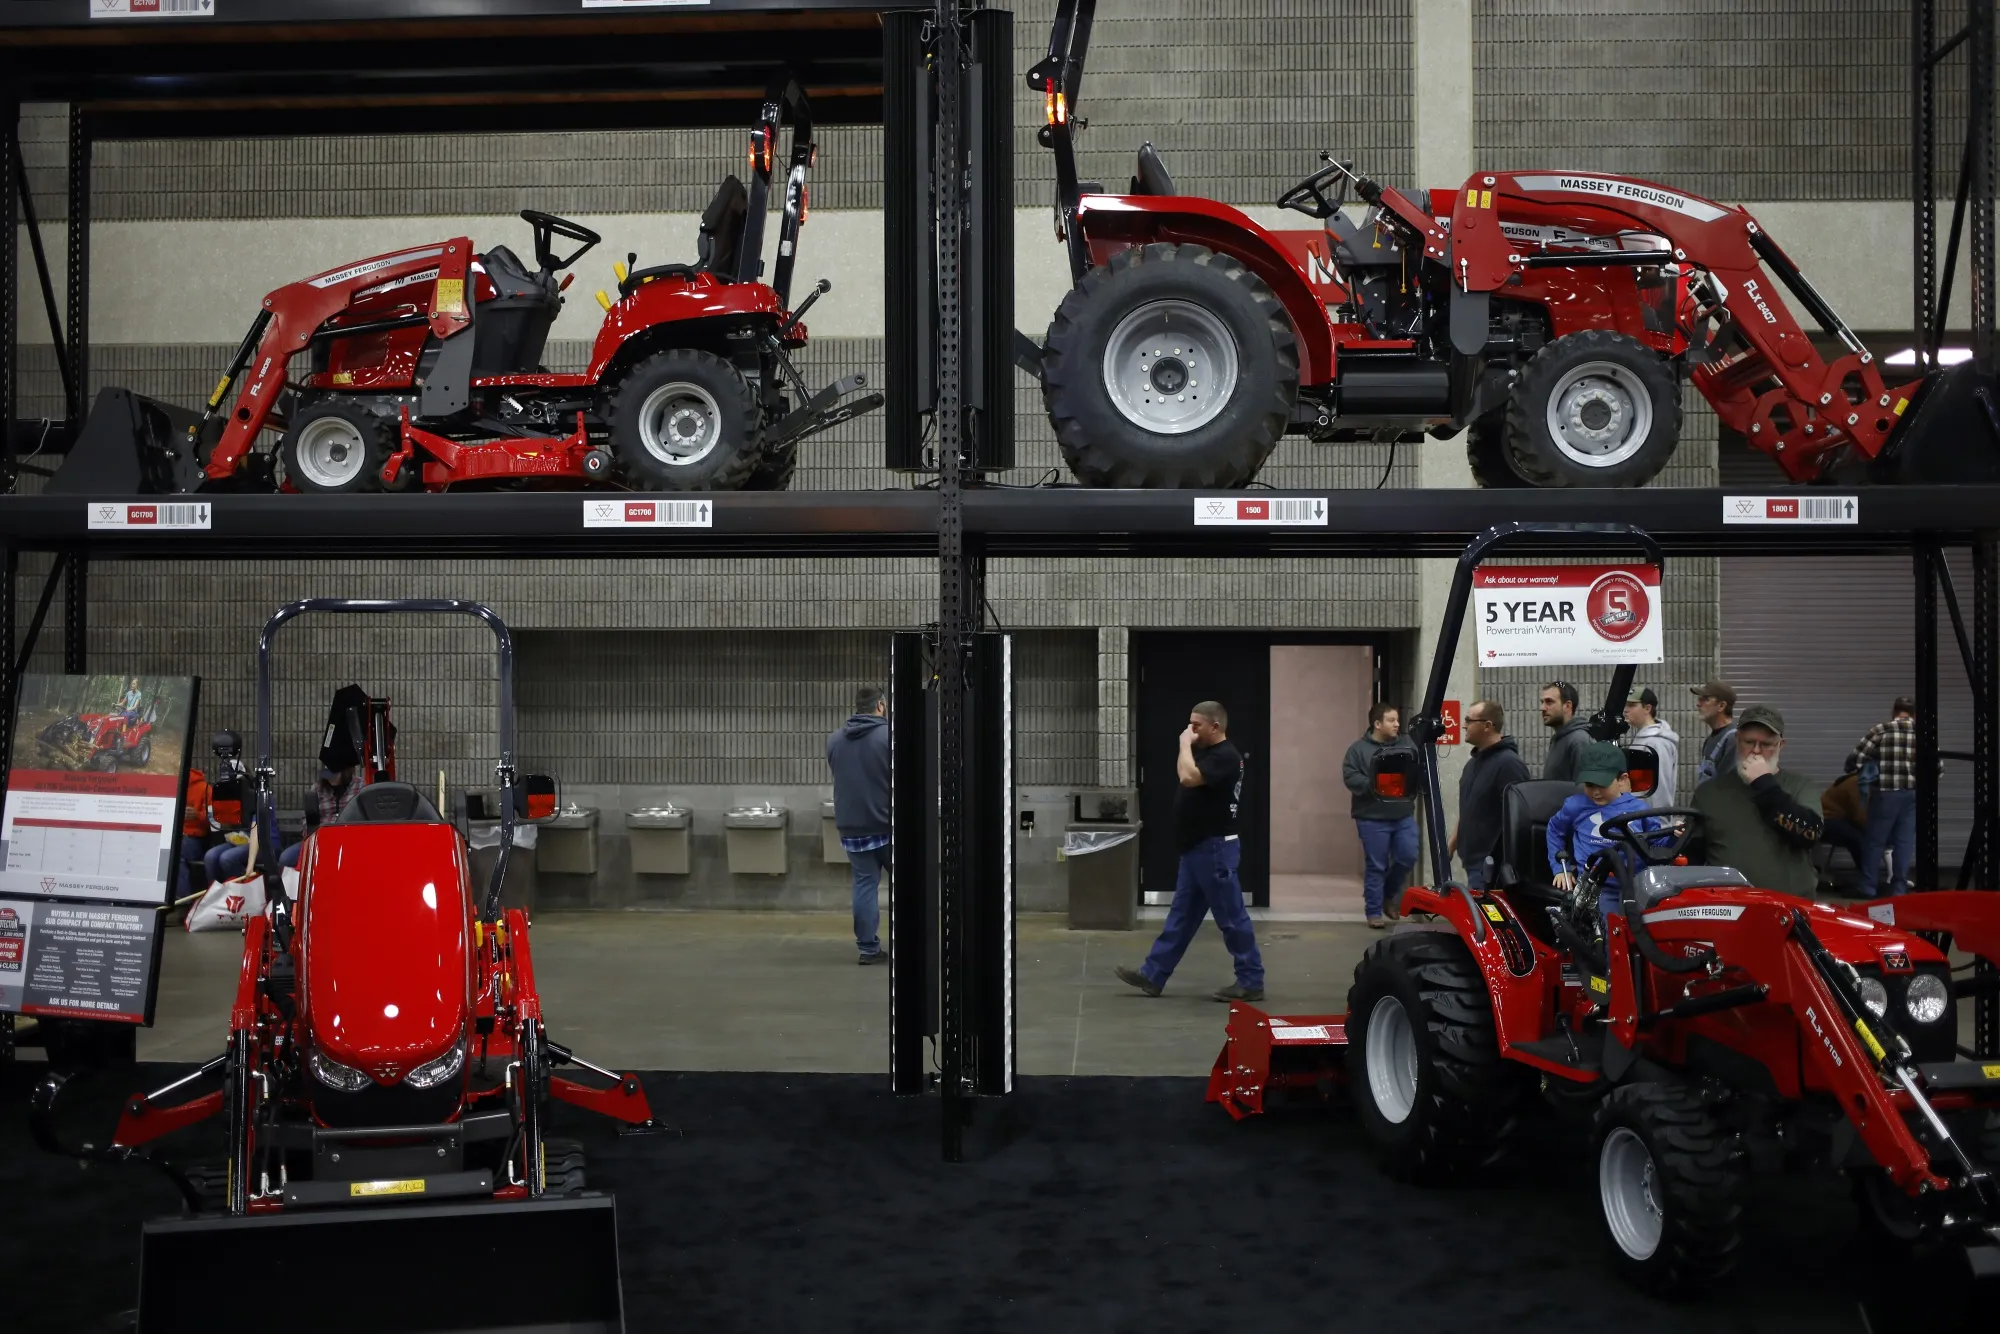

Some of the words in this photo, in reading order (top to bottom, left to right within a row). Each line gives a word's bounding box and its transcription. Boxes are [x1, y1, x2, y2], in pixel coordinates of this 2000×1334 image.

[1560, 178, 1614, 193] MASSEY
[1616, 185, 1685, 209] FERGUSON
[324, 270, 353, 285] MASSEY
[354, 259, 391, 275] FERGUSON
[410, 271, 438, 282] MASSEY
[1757, 301, 1777, 324] 2407
[250, 381, 262, 396] FL
[628, 508, 652, 516] GC1700
[1245, 506, 1262, 514] 1500
[1484, 575, 1496, 584] Ask
[1498, 575, 1516, 584] about
[1529, 575, 1559, 585] warranty!
[1486, 602, 1498, 623] 5
[1503, 601, 1575, 623] YEAR
[1486, 625, 1534, 635] Powertrain
[1534, 625, 1576, 636] Warranty
[85, 884, 119, 892] FERGUSON
[51, 910, 70, 918] BUYING
[75, 911, 88, 919] NEW
[88, 912, 111, 920] MASSEY
[111, 913, 140, 922] FERGUSON
[1678, 908, 1701, 917] MASSEY
[1701, 908, 1732, 917] FERGUSON
[56, 918, 81, 926] COMPACT
[90, 920, 115, 929] COMPACT
[116, 922, 143, 931] TRACTOR?
[49, 997, 60, 1005] ASK
[60, 998, 68, 1006] US
[68, 999, 79, 1007] FOR
[80, 1000, 96, 1008] MORE
[96, 1001, 120, 1011] DETAILS!
